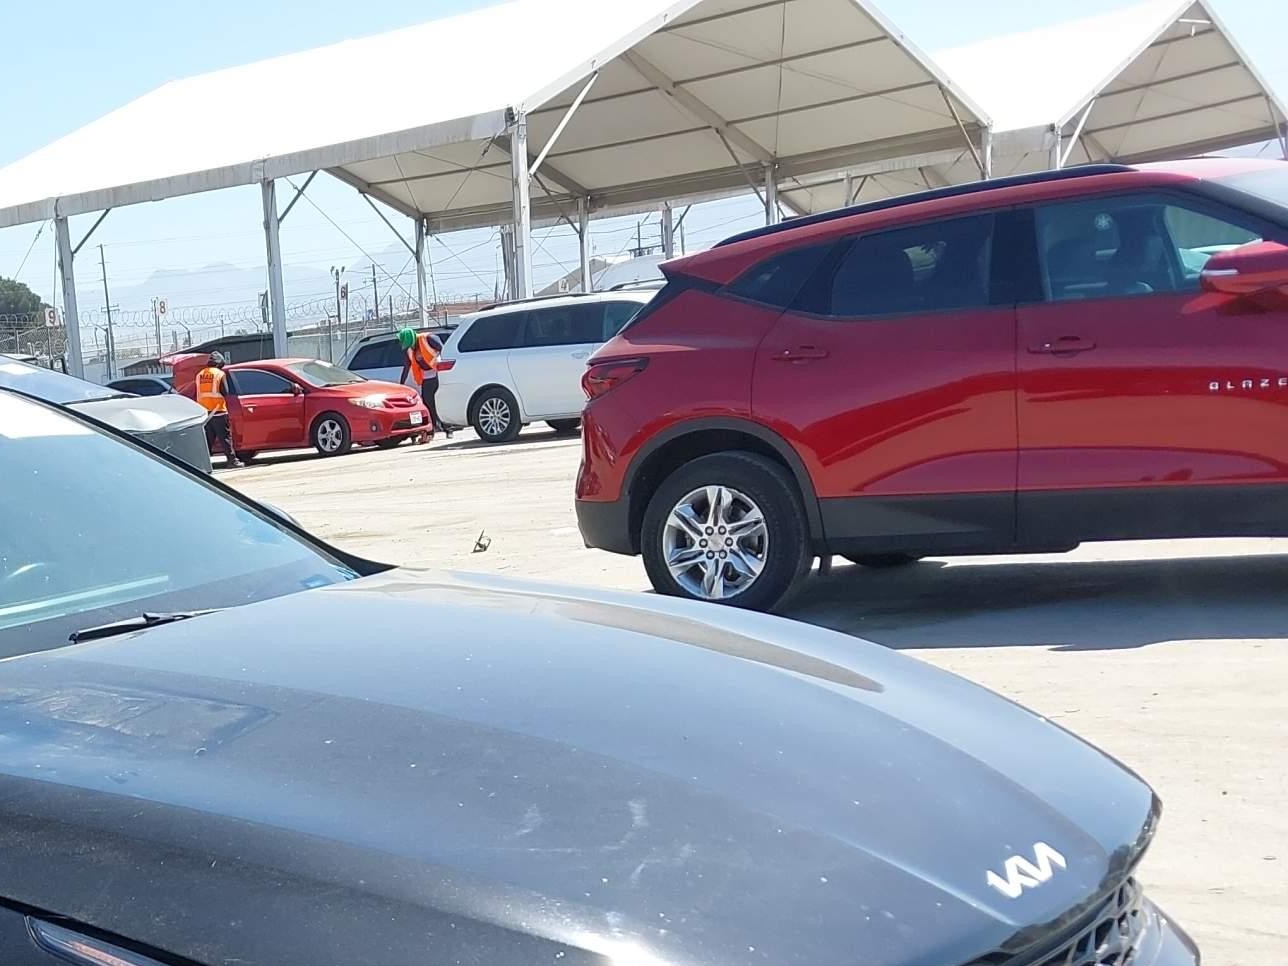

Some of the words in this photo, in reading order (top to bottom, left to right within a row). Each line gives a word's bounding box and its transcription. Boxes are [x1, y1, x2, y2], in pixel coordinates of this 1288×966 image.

[341, 286, 346, 298] 6
[159, 300, 166, 314] 8
[48, 310, 56, 325] 9
